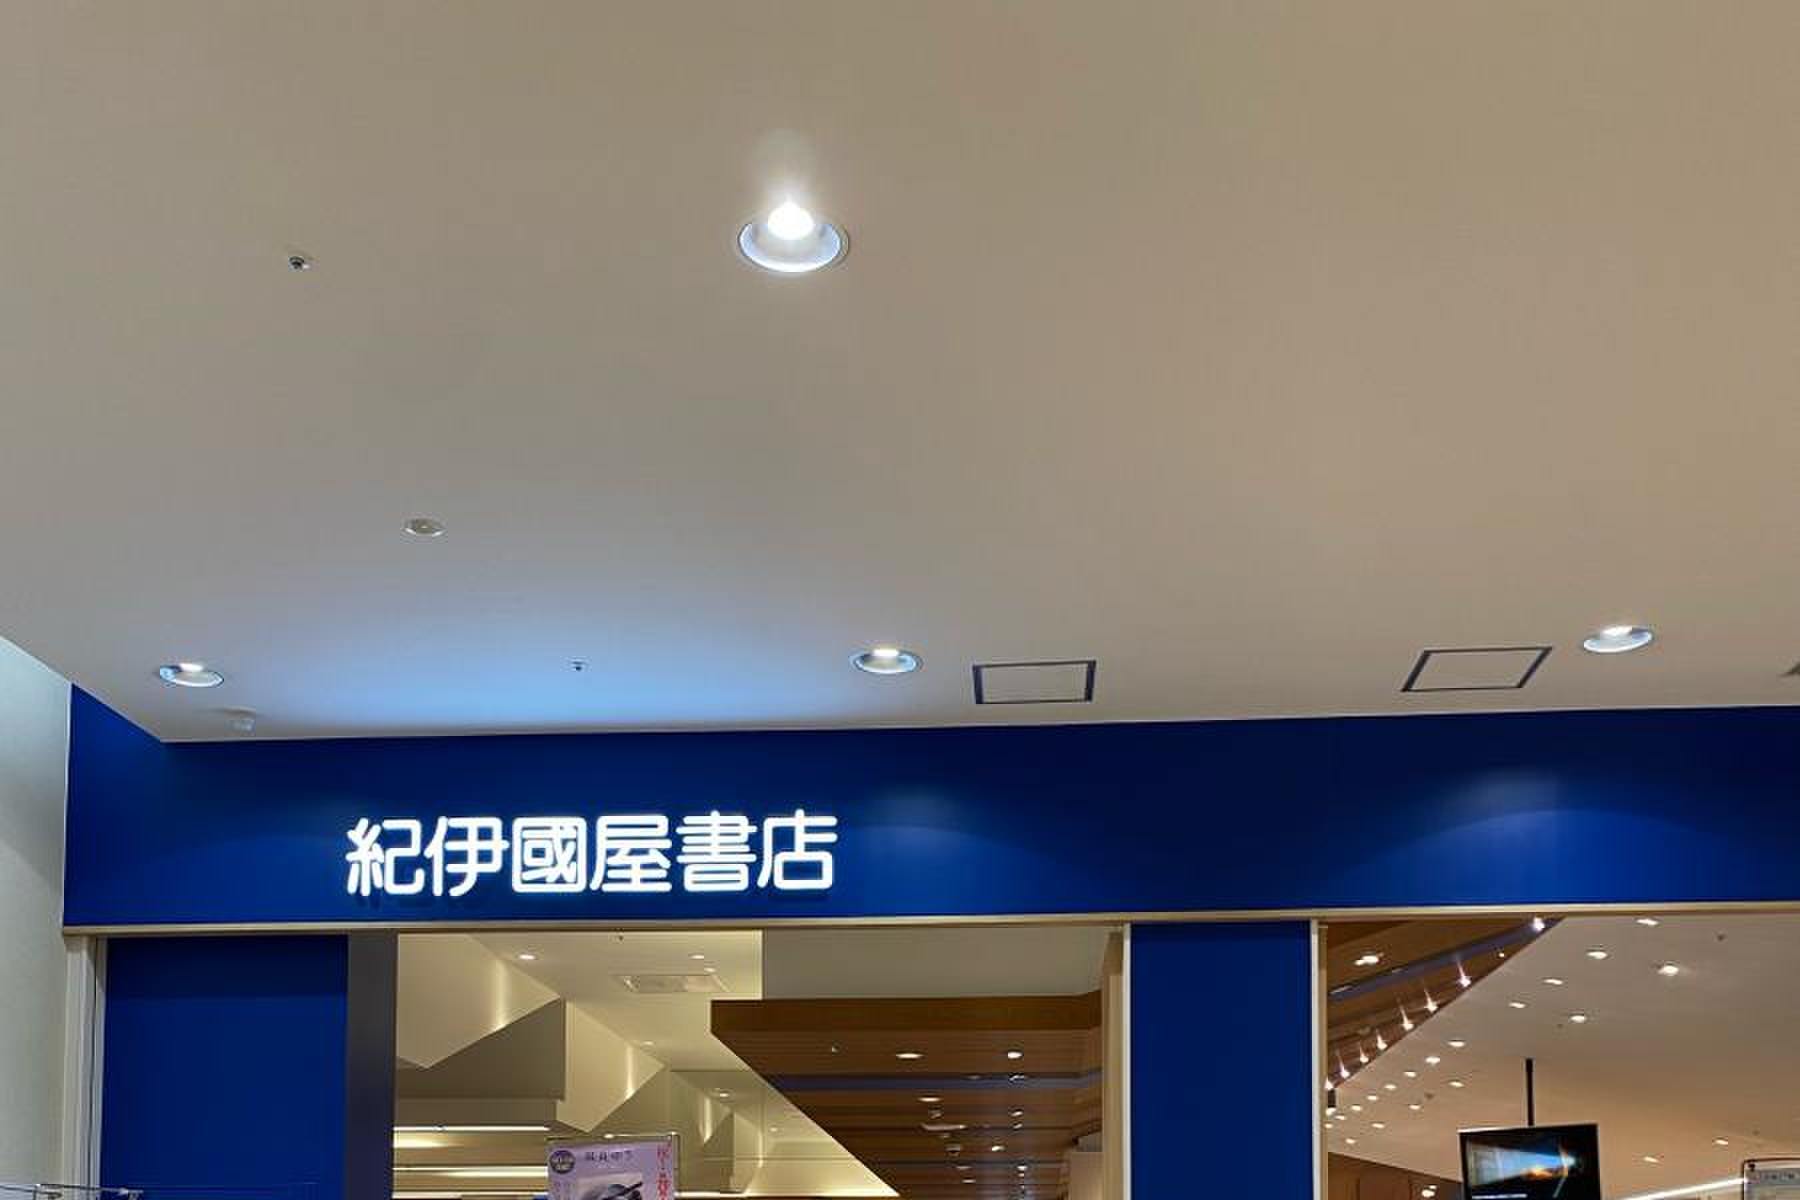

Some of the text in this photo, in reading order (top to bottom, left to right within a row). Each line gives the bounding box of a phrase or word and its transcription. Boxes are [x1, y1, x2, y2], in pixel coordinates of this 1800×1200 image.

[345, 809, 838, 897] 紀伊國屋書店
